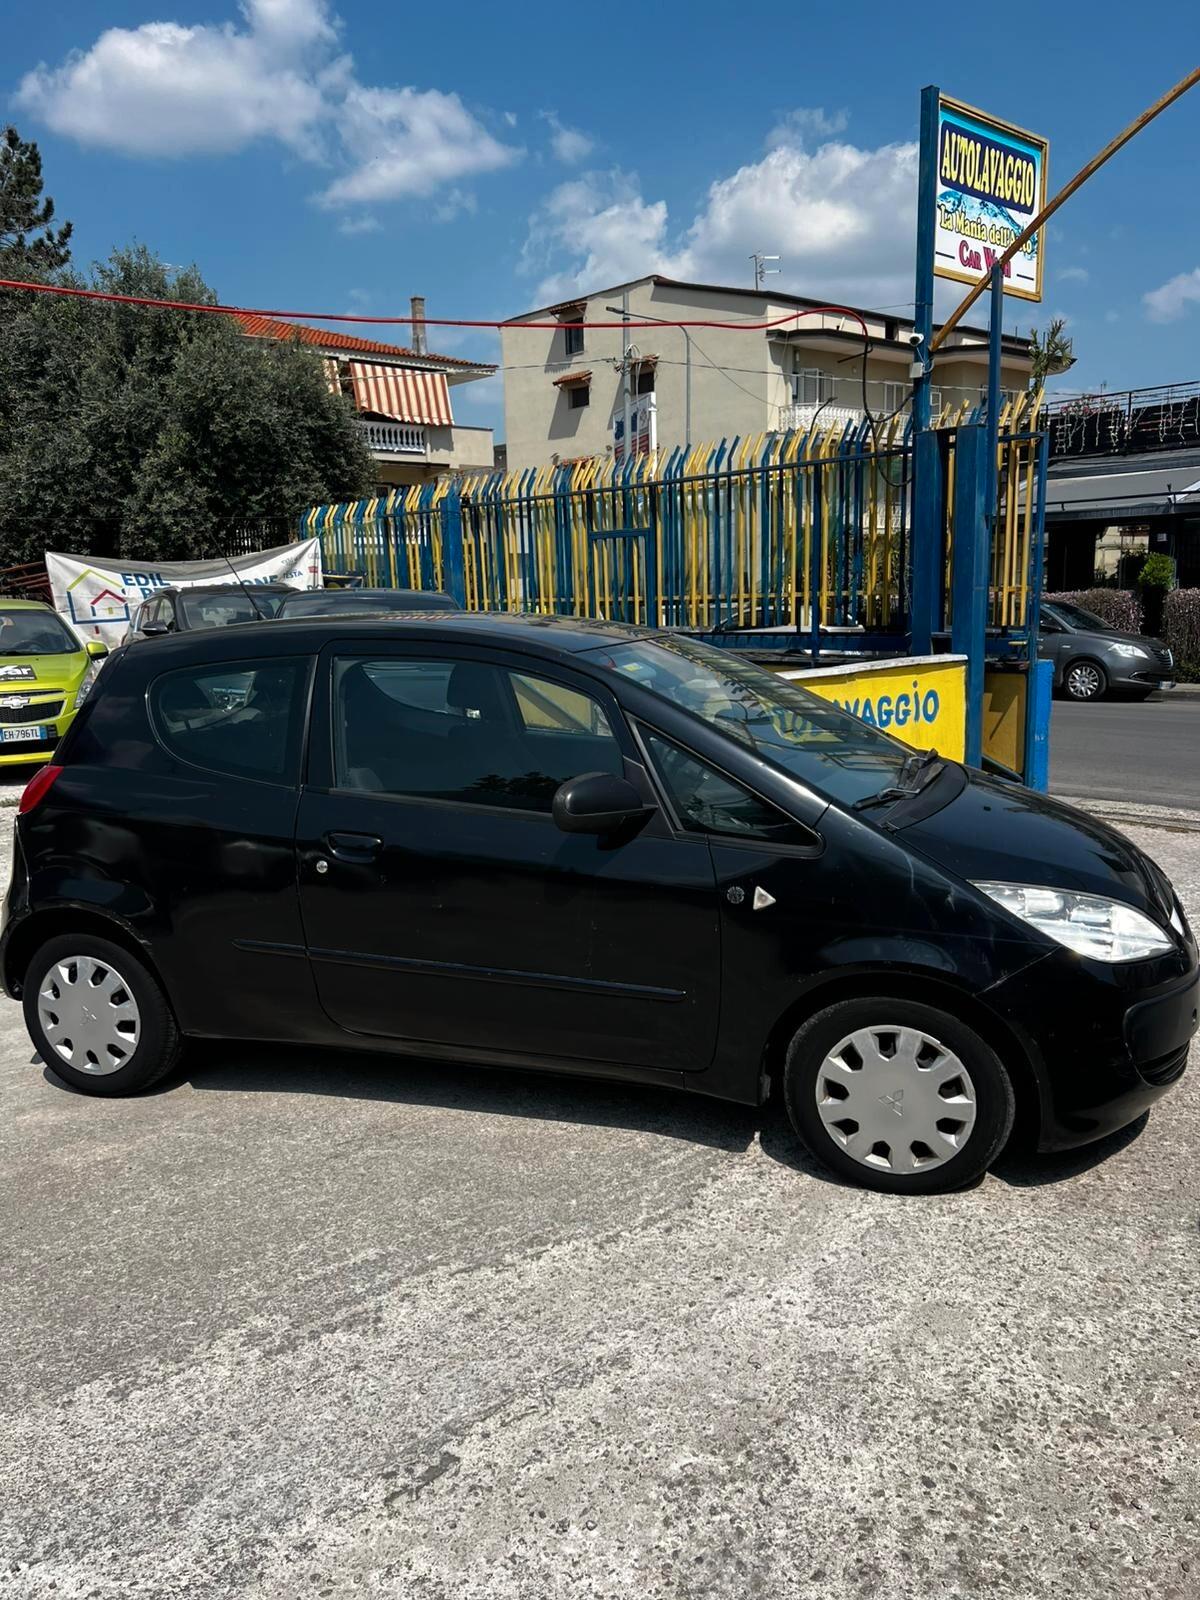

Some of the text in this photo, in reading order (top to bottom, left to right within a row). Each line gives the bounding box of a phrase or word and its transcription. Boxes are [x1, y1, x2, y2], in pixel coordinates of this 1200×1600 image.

[941, 129, 1035, 207] AUTOLAVAGGIO
[939, 204, 953, 231] La
[954, 210, 988, 242] Mania
[121, 573, 170, 586] EDIL
